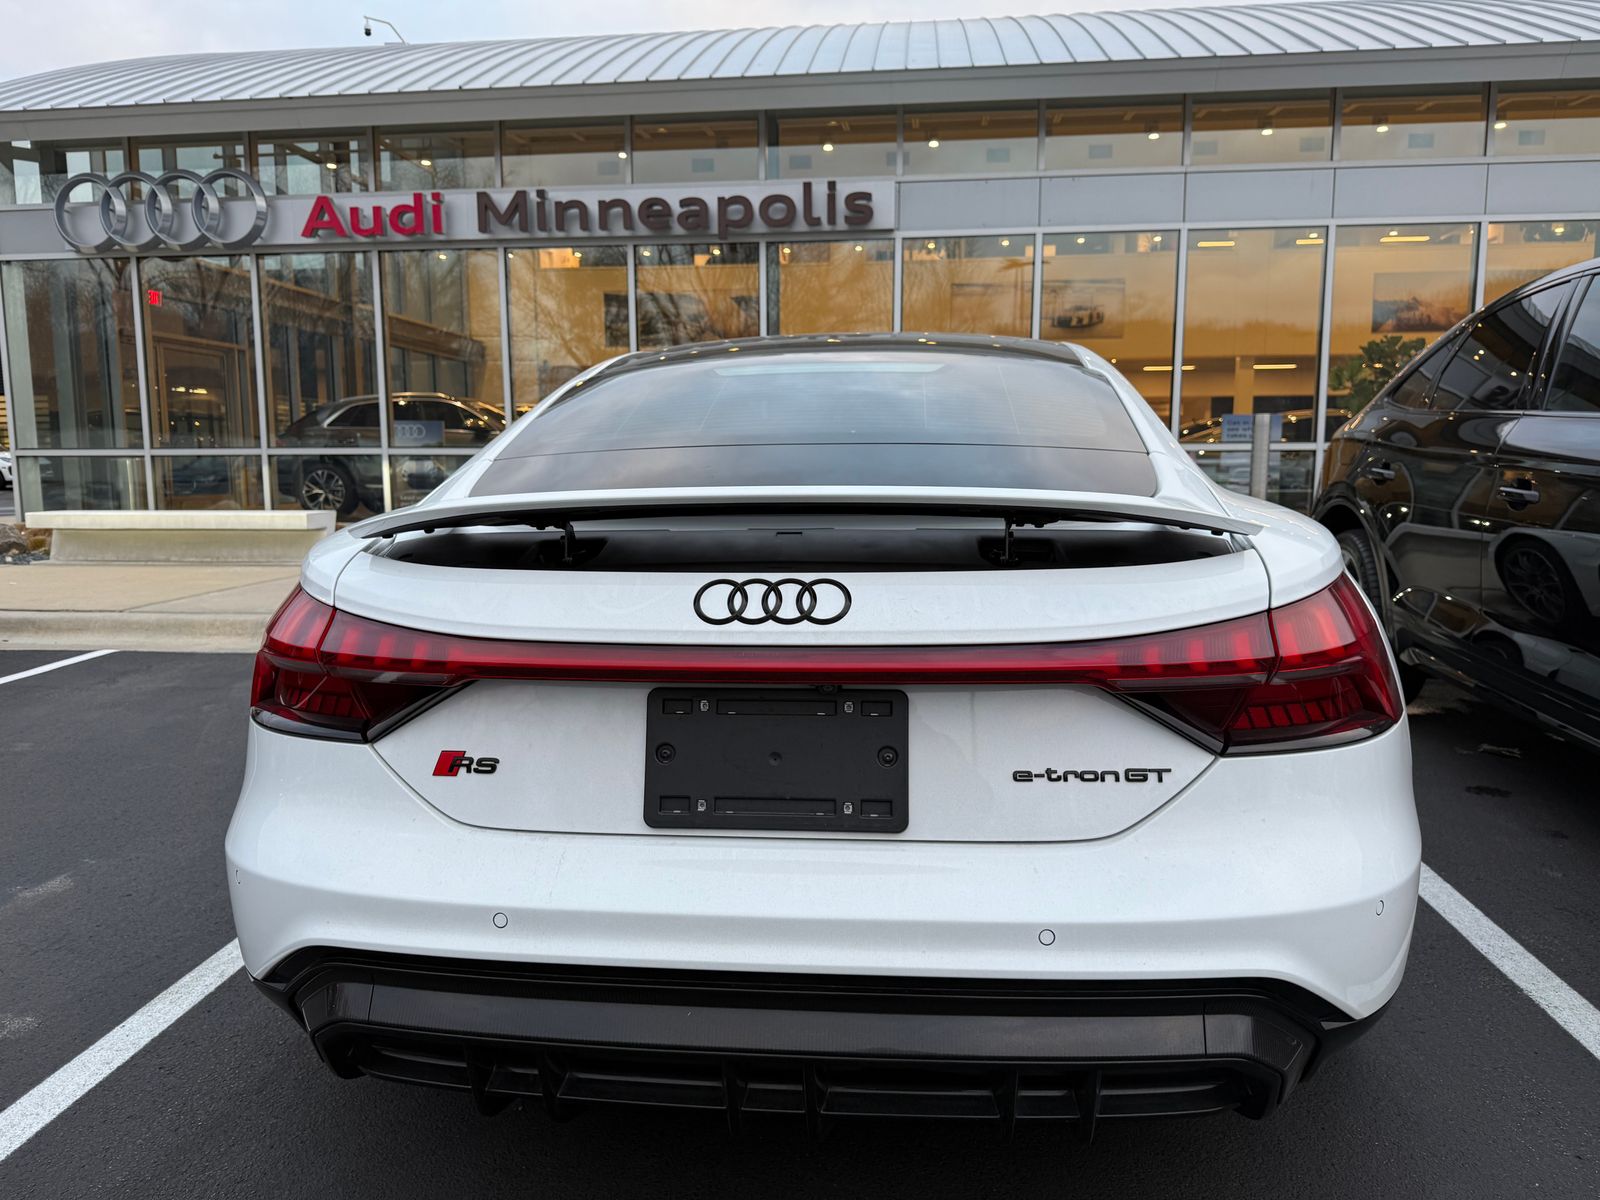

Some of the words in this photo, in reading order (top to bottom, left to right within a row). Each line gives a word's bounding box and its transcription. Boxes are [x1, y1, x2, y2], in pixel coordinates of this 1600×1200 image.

[301, 191, 446, 238] Audi
[476, 180, 874, 240] Minneapolis
[447, 756, 500, 775] RS
[1012, 767, 1120, 783] e-tron
[1124, 767, 1172, 783] GT
